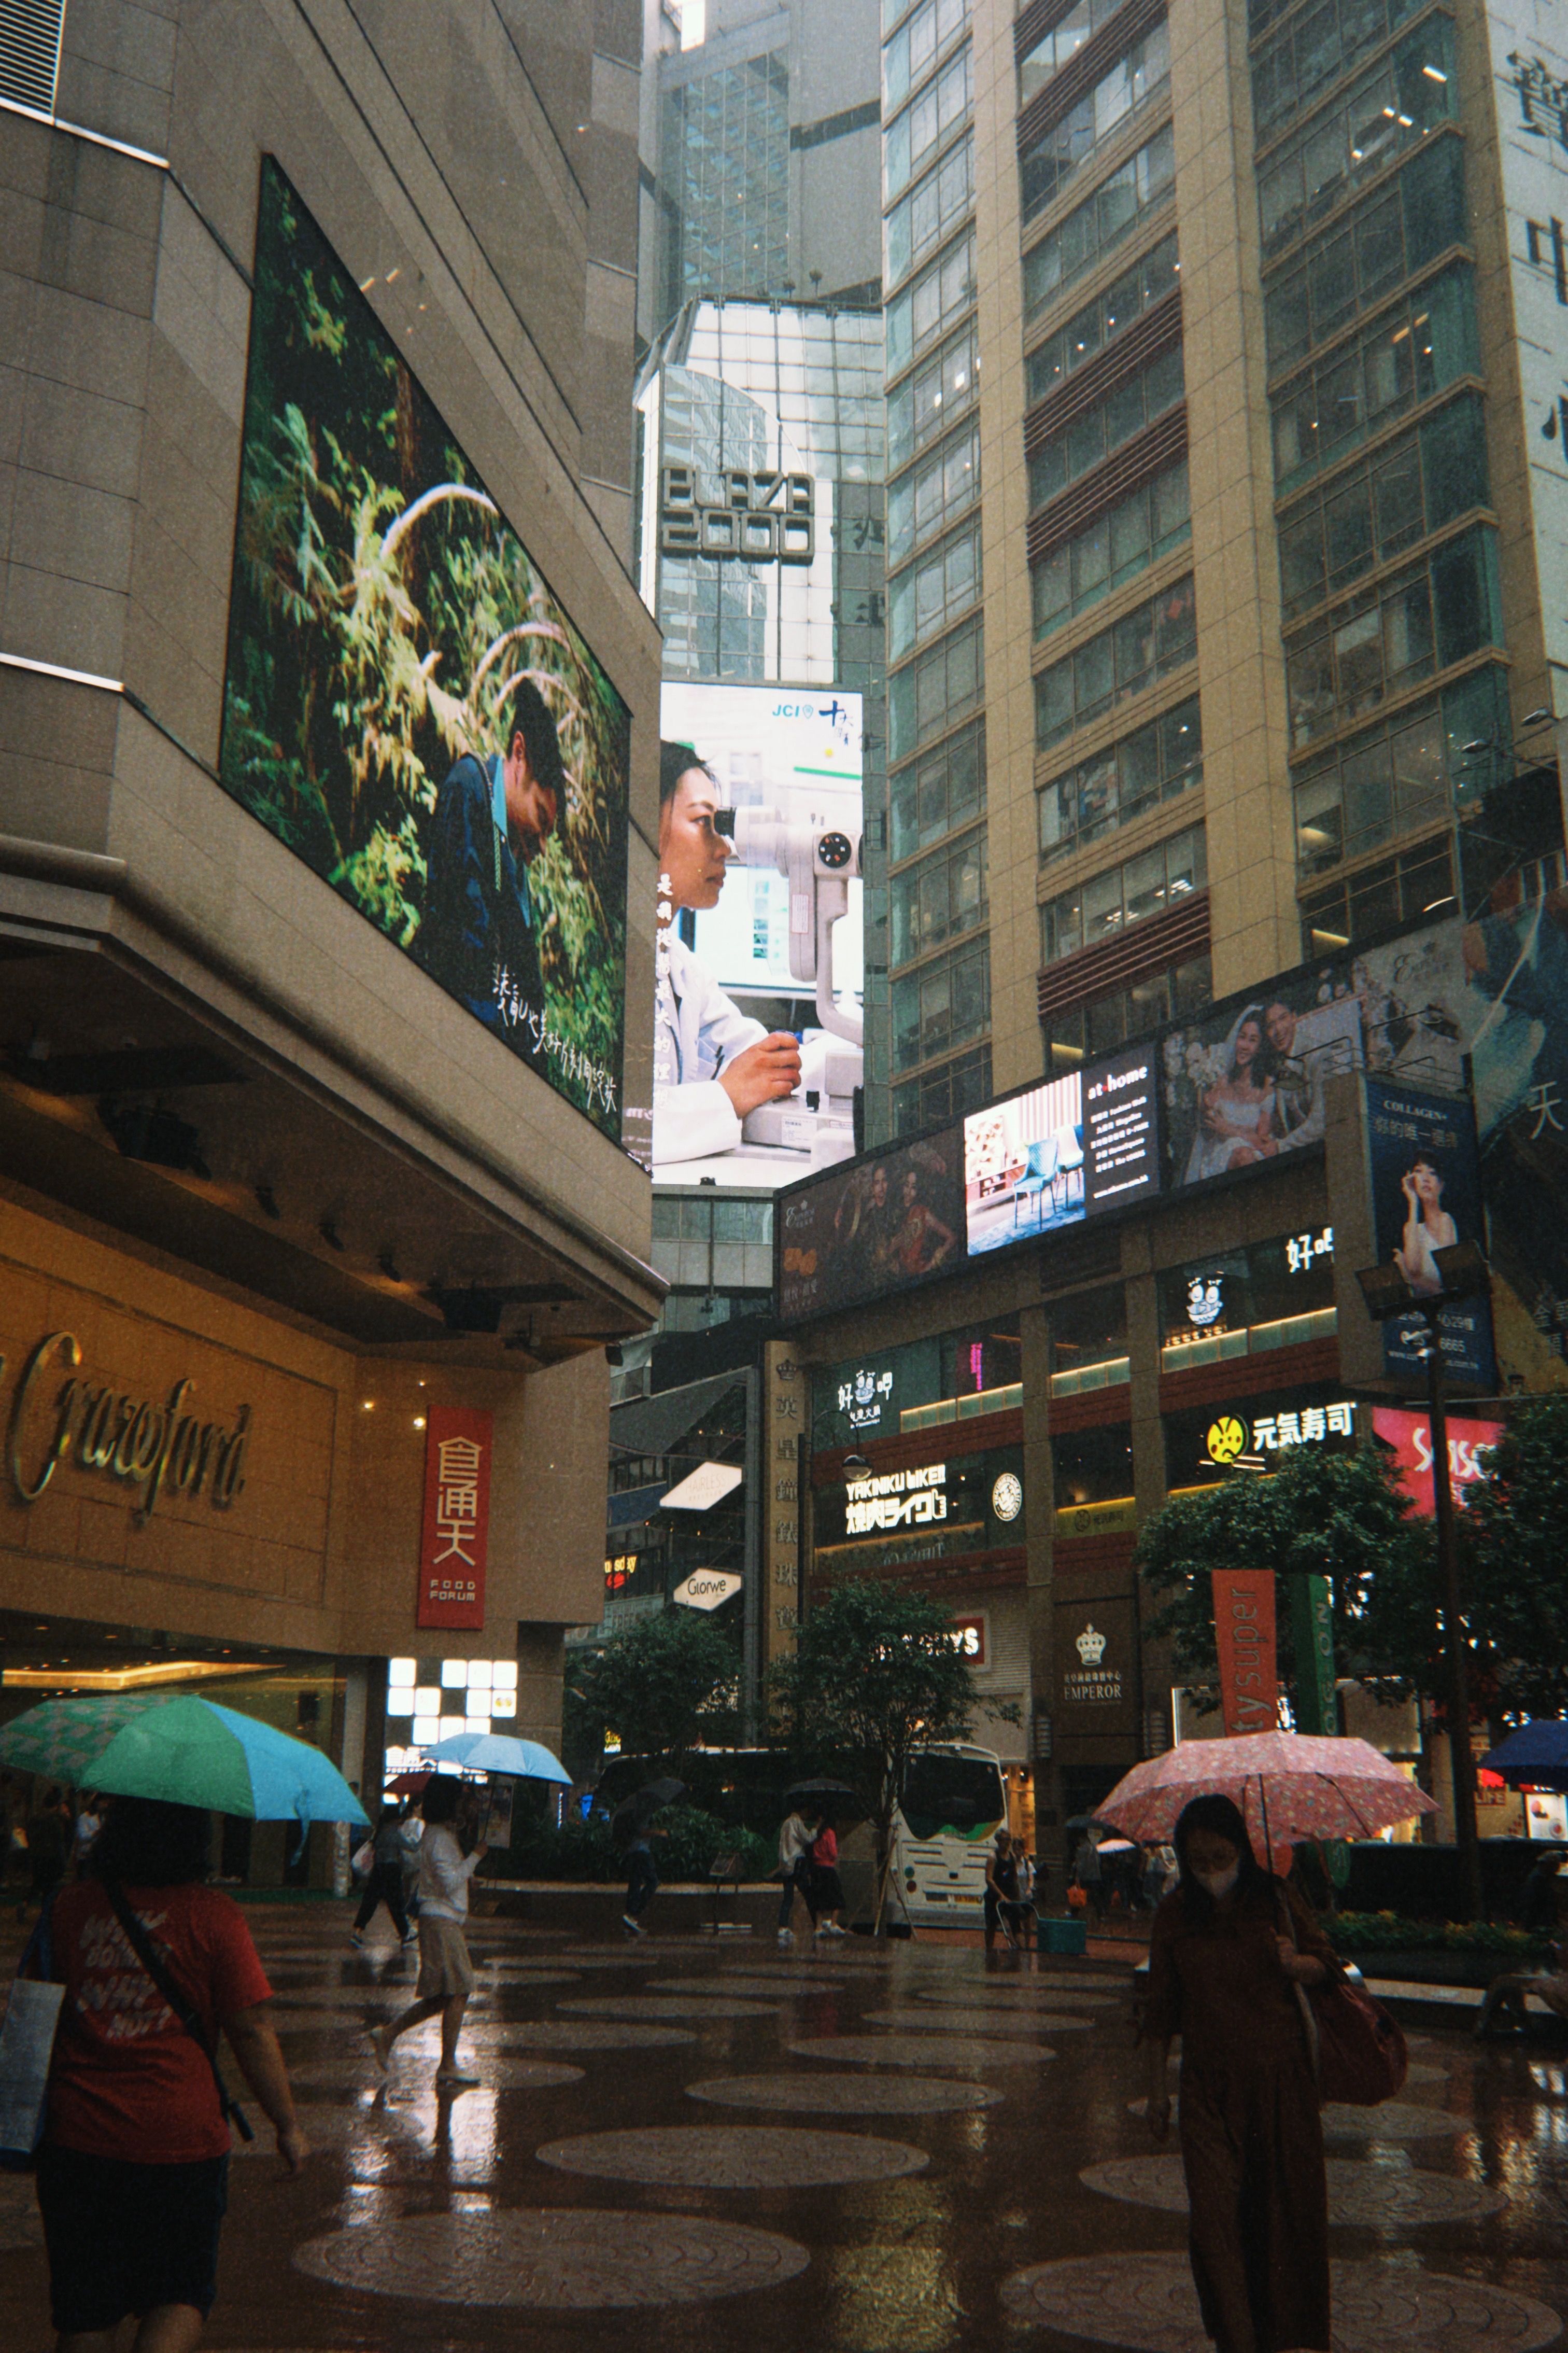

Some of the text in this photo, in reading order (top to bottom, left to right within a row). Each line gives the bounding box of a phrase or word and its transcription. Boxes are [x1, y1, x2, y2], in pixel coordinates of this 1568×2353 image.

[663, 465, 815, 514] PLAZA
[661, 507, 815, 560] 2000
[772, 704, 800, 718] JCI
[1253, 1402, 1355, 1452] 元気寿司
[845, 1473, 905, 1502] YAKINIKU
[775, 1398, 799, 1663] 英皇鐘錶珠寶
[429, 1591, 475, 1602] FORUM
[430, 1579, 475, 1591] FOOD
[1231, 1587, 1273, 1732] ty'super
[1316, 1602, 1337, 1735] OG-ON
[1064, 1684, 1122, 1701] EMPEROR
